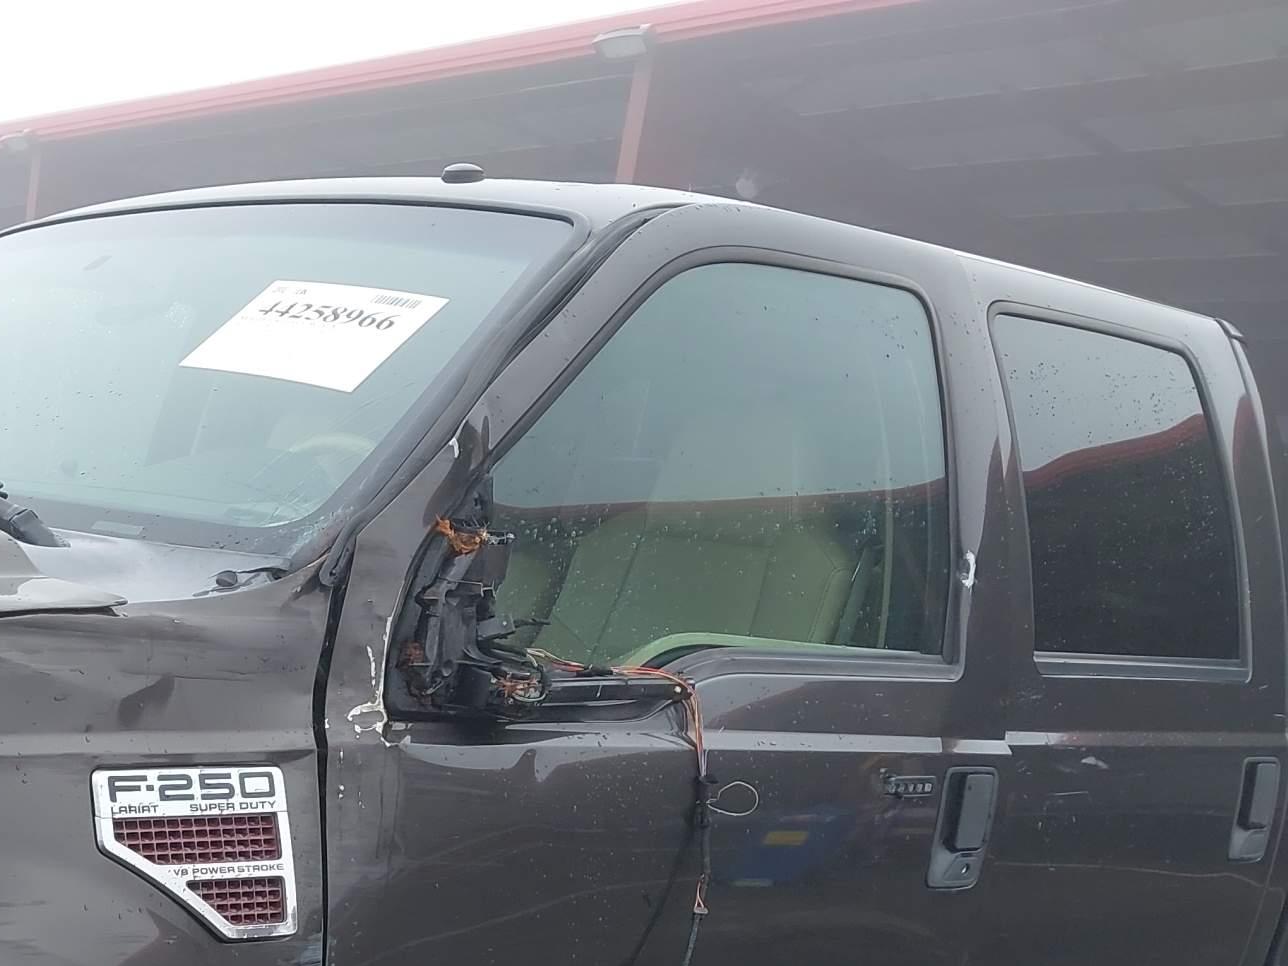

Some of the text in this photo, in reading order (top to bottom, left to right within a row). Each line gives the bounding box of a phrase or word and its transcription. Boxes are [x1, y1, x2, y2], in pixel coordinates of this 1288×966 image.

[258, 300, 401, 331] 44258966
[108, 771, 276, 803] F-250
[111, 803, 159, 815] LARIAT
[189, 800, 277, 813] SUPER DUTY
[173, 862, 285, 877] V8 POWER STROKE
